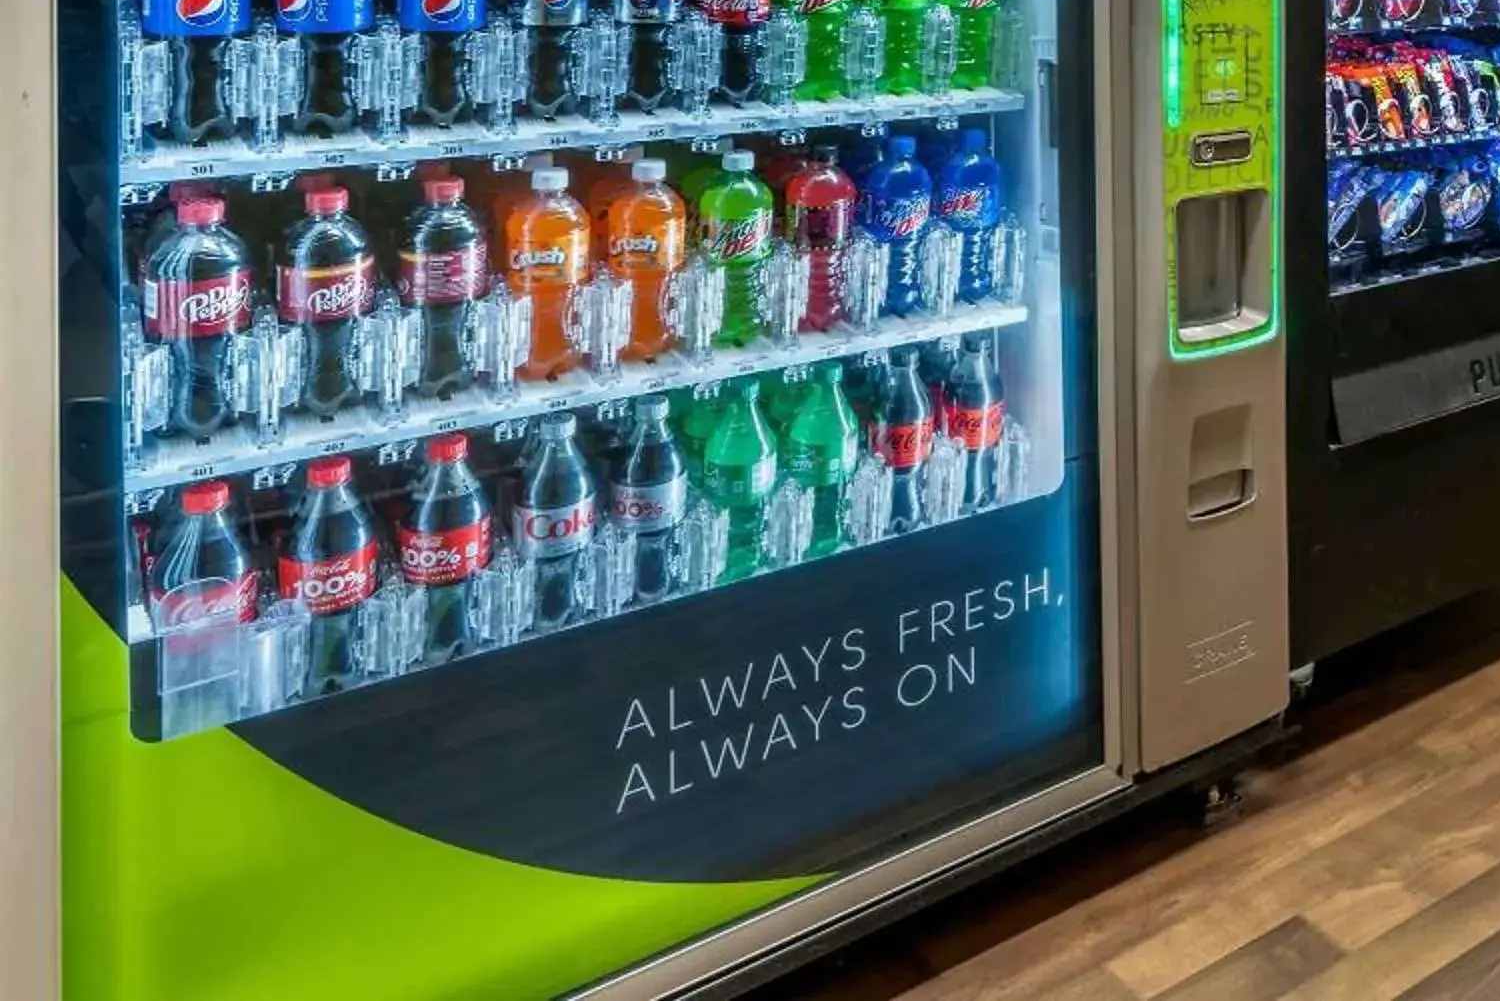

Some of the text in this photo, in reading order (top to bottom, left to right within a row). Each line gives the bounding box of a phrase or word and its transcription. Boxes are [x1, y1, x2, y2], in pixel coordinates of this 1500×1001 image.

[322, 154, 345, 165] 302
[191, 165, 214, 176] 301
[191, 465, 214, 477] 401
[294, 571, 368, 599] 100%
[615, 567, 1065, 750] ALWAYS FRESH,
[616, 646, 976, 815] ALWAYS ON
